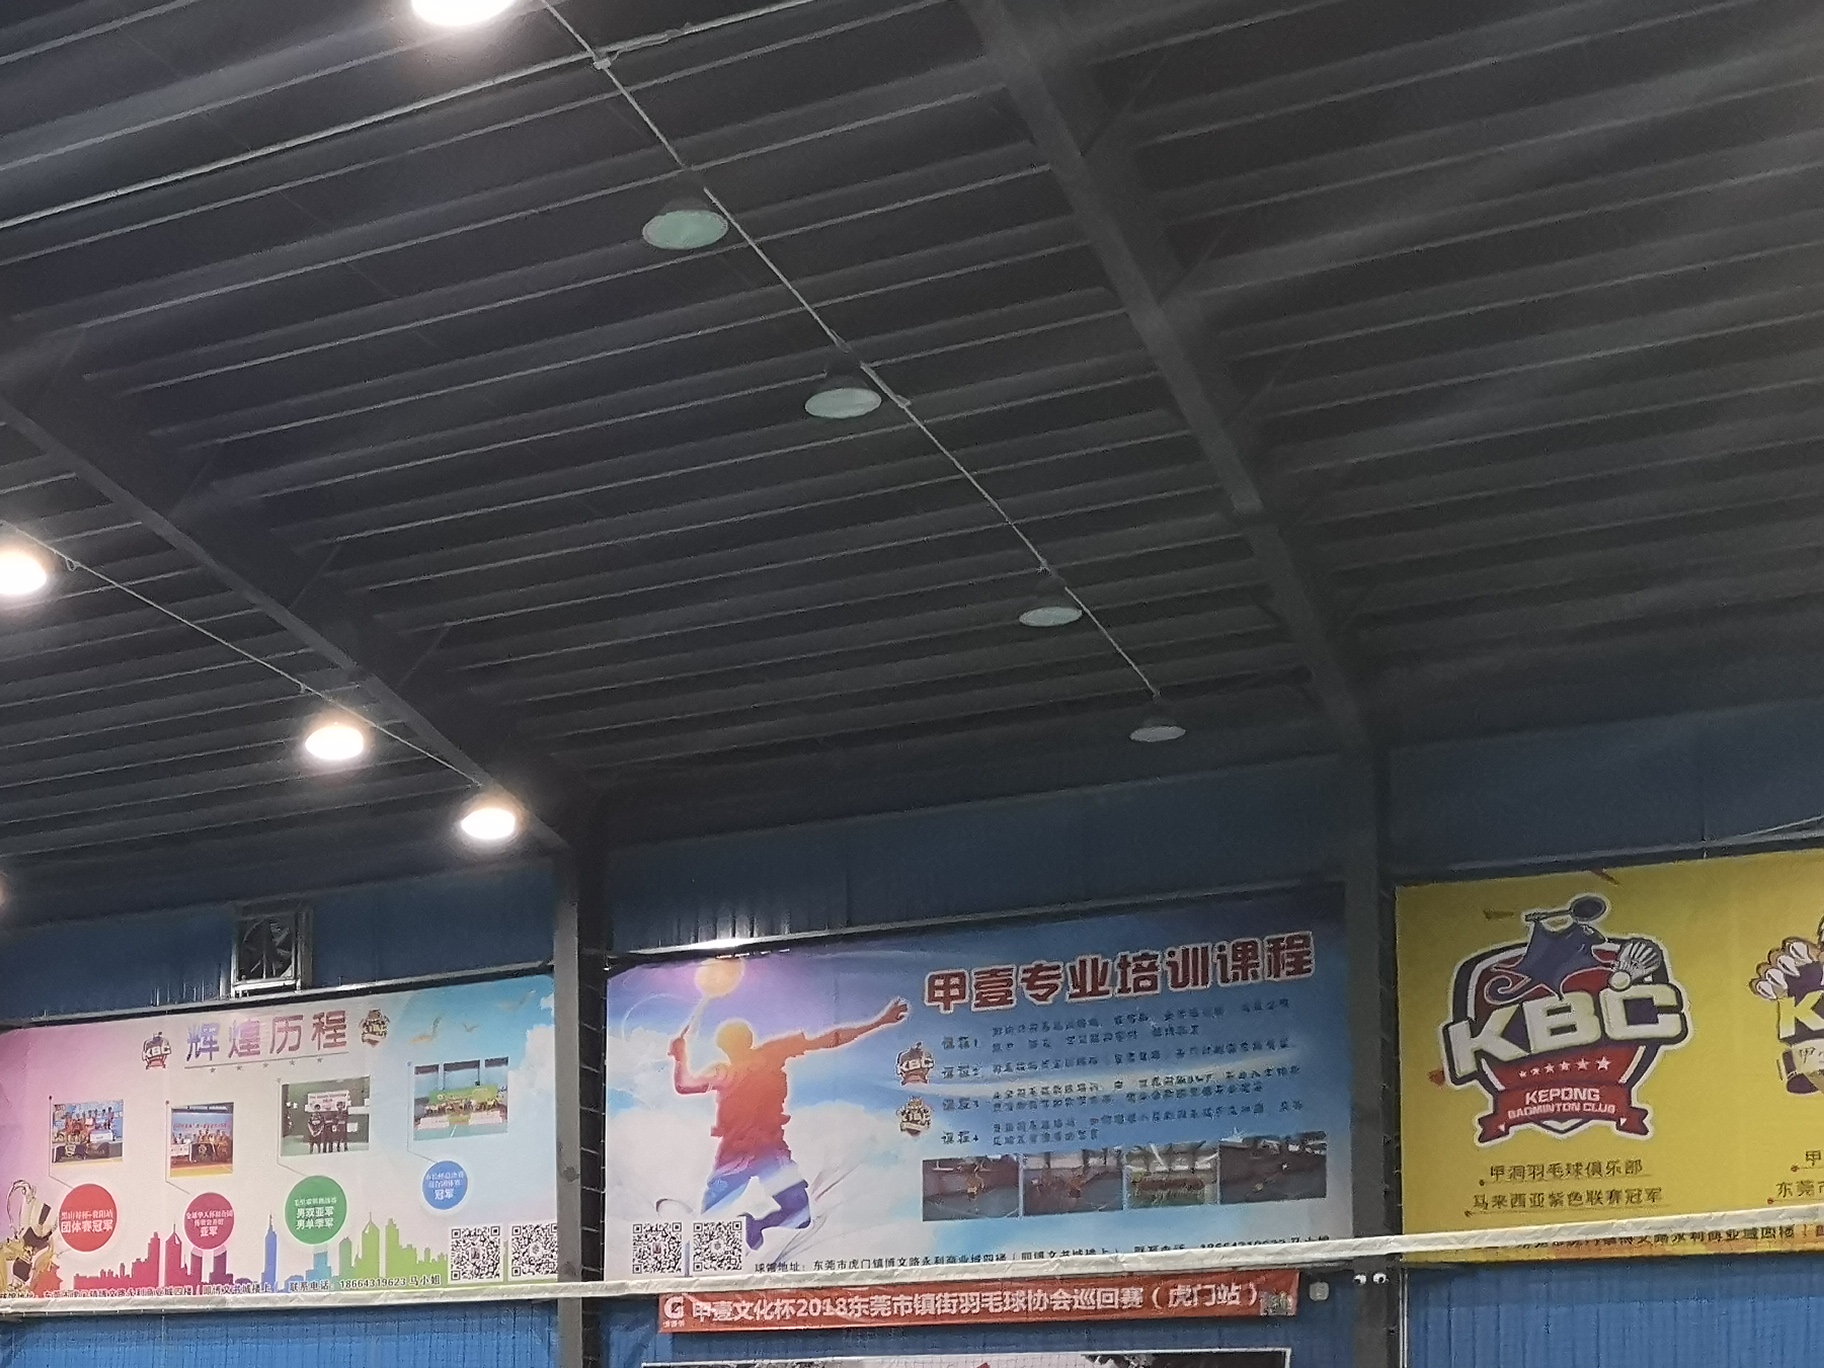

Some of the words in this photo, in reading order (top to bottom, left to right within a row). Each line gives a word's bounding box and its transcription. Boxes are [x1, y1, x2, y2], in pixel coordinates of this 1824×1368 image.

[926, 931, 1314, 1013] 甲壹专业培训课程
[186, 1009, 347, 1062] 辉煌历程
[1449, 984, 1683, 1078] KBC
[1525, 1087, 1601, 1105] KEPONG
[1507, 1102, 1581, 1119] BADMINTON
[1584, 1103, 1616, 1114] CLUB
[1489, 1158, 1644, 1182] 甲洞羽毛球俱乐部
[1472, 1187, 1663, 1211] 马来西亚紫色联赛冠军
[60, 1219, 114, 1233] 团体赛冠军
[340, 1278, 406, 1289] 18664319623
[409, 1275, 441, 1286] 马小姐
[693, 1283, 1258, 1323] 甲壹文化杯2018东莞市镇街羽毛球协会巡回赛（虎门站）
